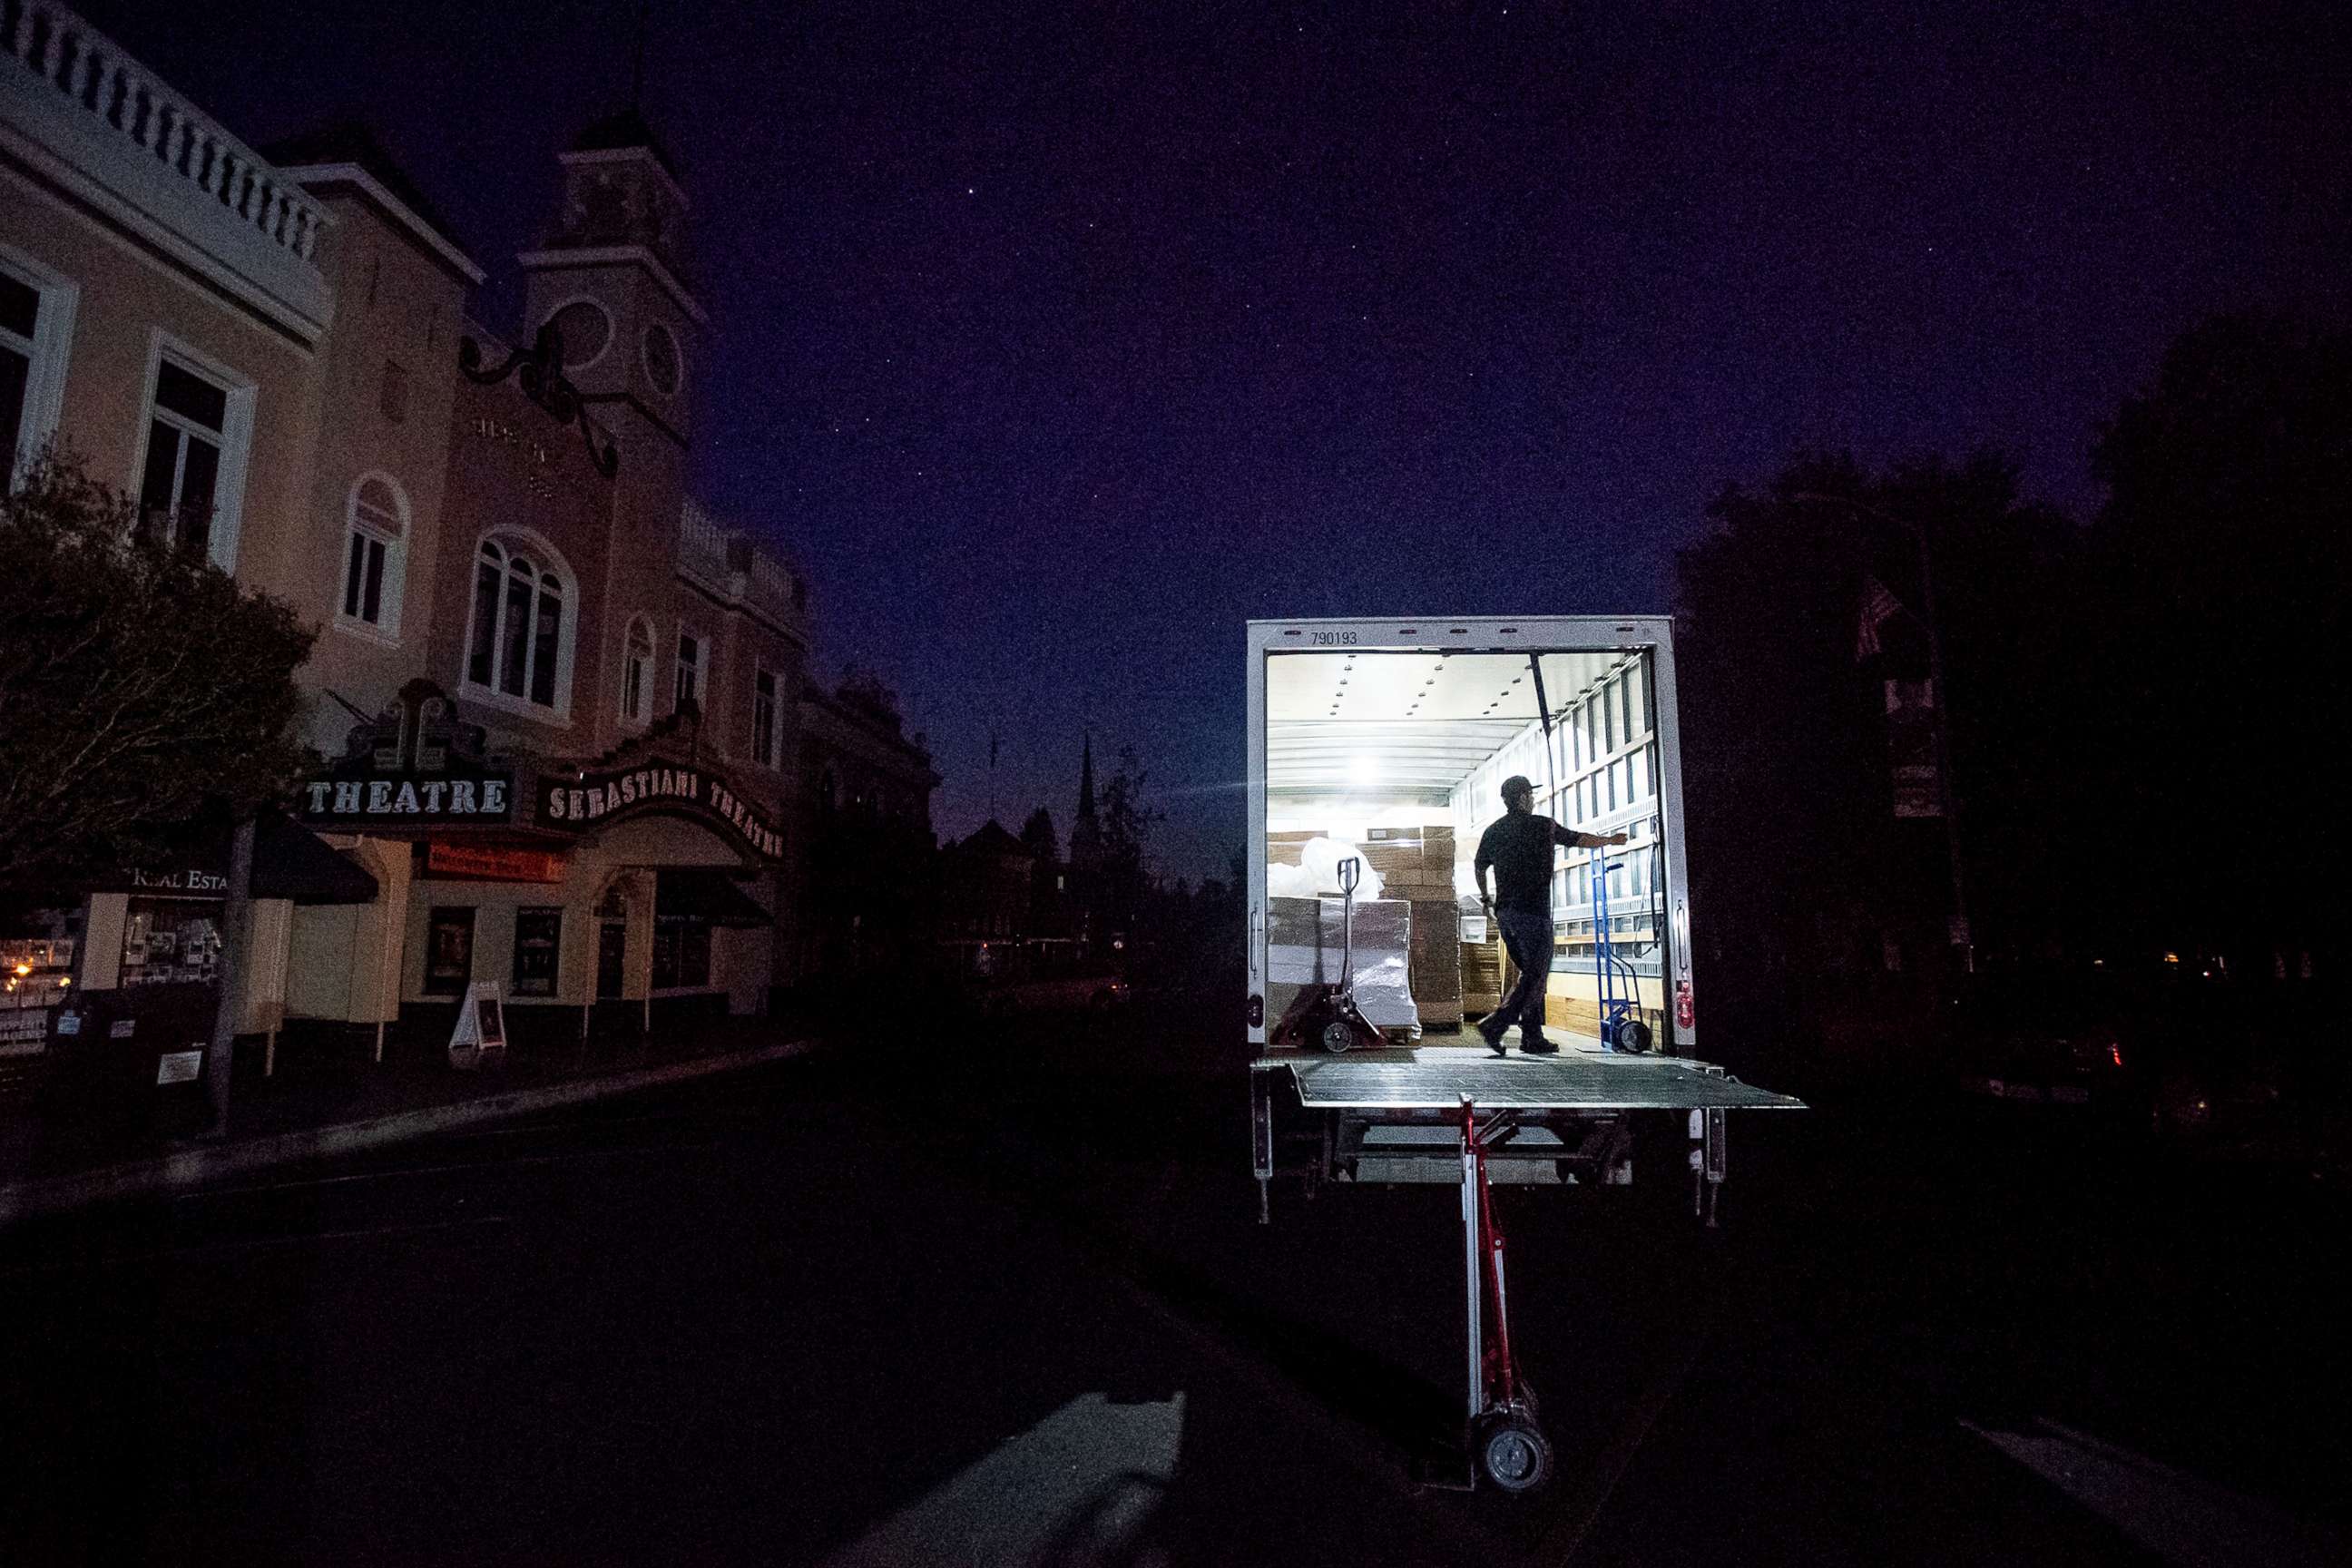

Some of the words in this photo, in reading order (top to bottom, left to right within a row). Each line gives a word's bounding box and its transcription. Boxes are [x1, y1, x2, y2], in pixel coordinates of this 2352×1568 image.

[1310, 631, 1357, 645] 790193
[305, 779, 508, 815] THEATRE
[549, 769, 699, 821] SEBASTIANI
